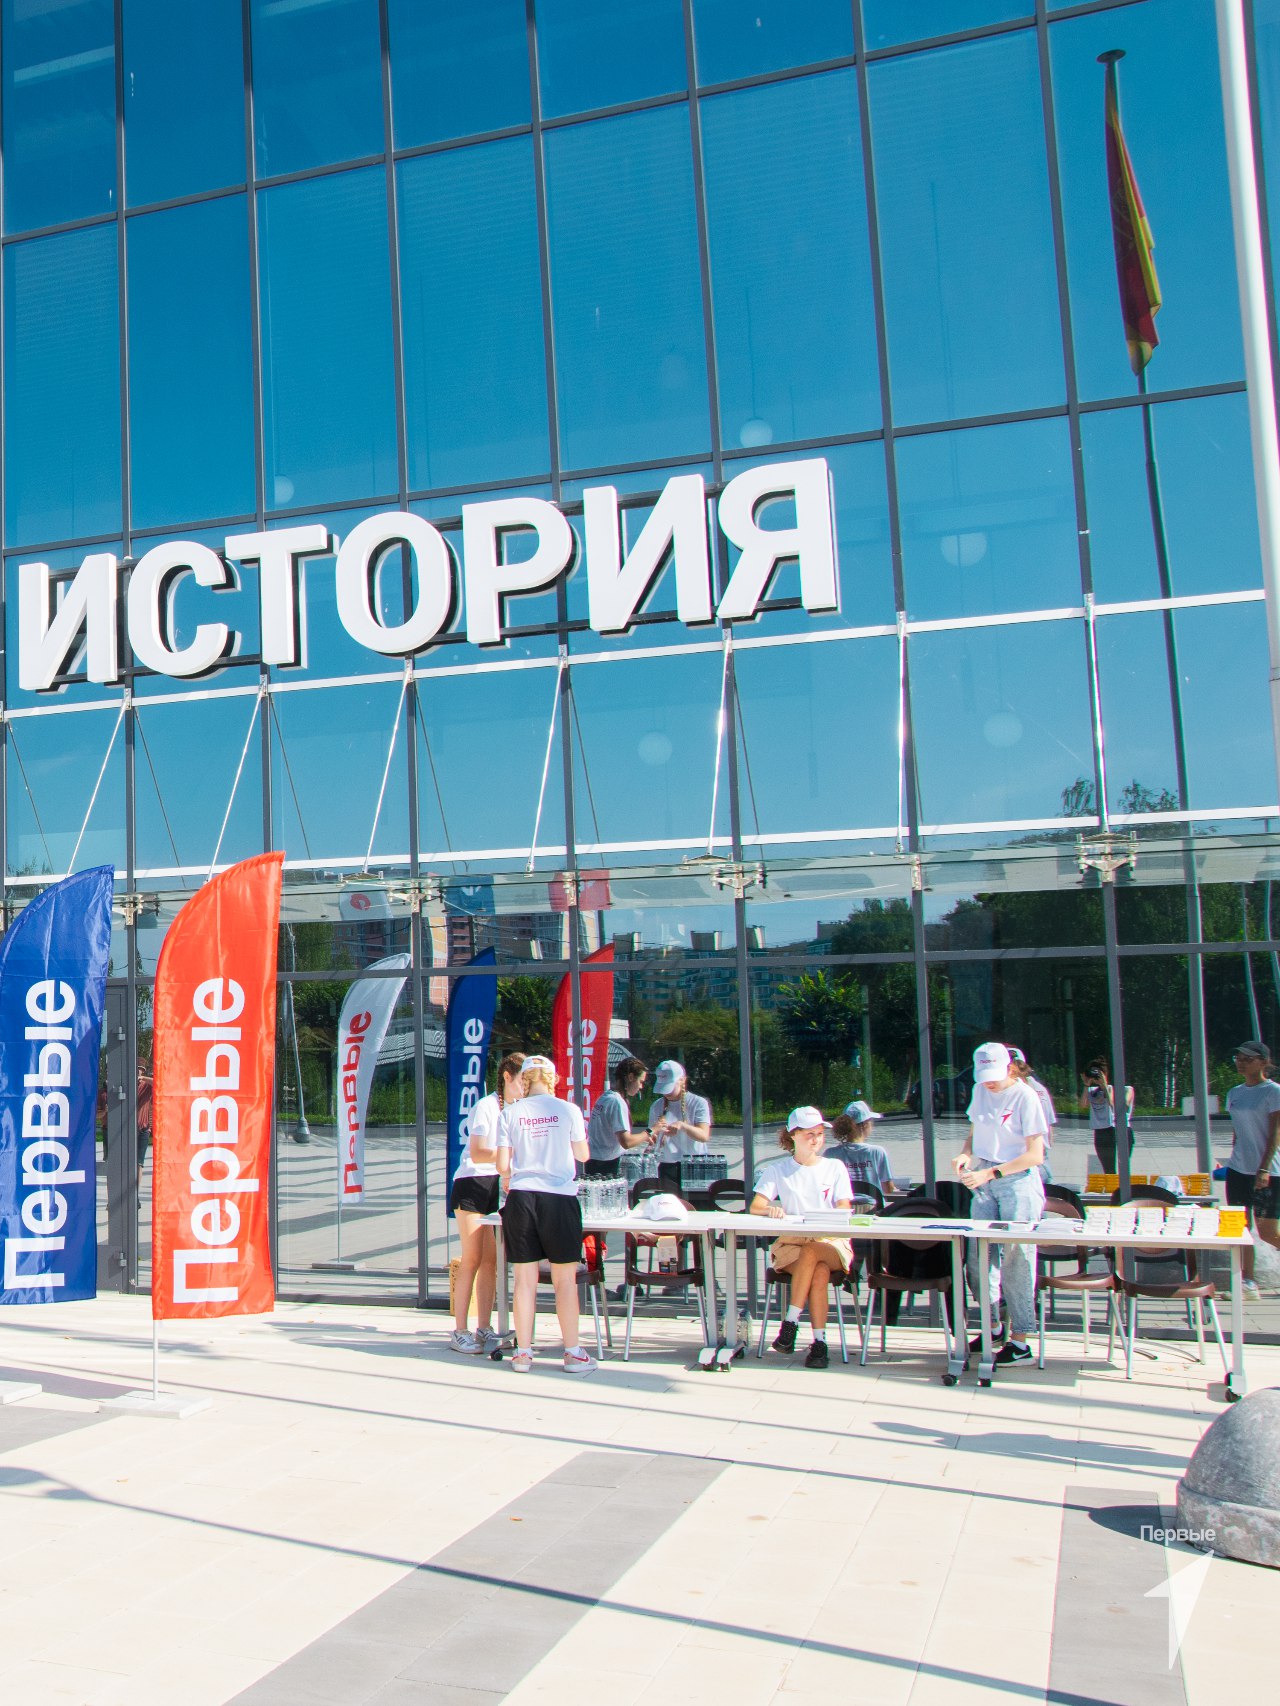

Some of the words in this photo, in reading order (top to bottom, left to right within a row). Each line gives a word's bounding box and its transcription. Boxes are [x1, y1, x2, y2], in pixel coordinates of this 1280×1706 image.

[16, 456, 840, 692] ИСТОРИЯ
[3, 978, 86, 1291] Первые
[172, 976, 260, 1304] Первые
[519, 1115, 559, 1128] Первые
